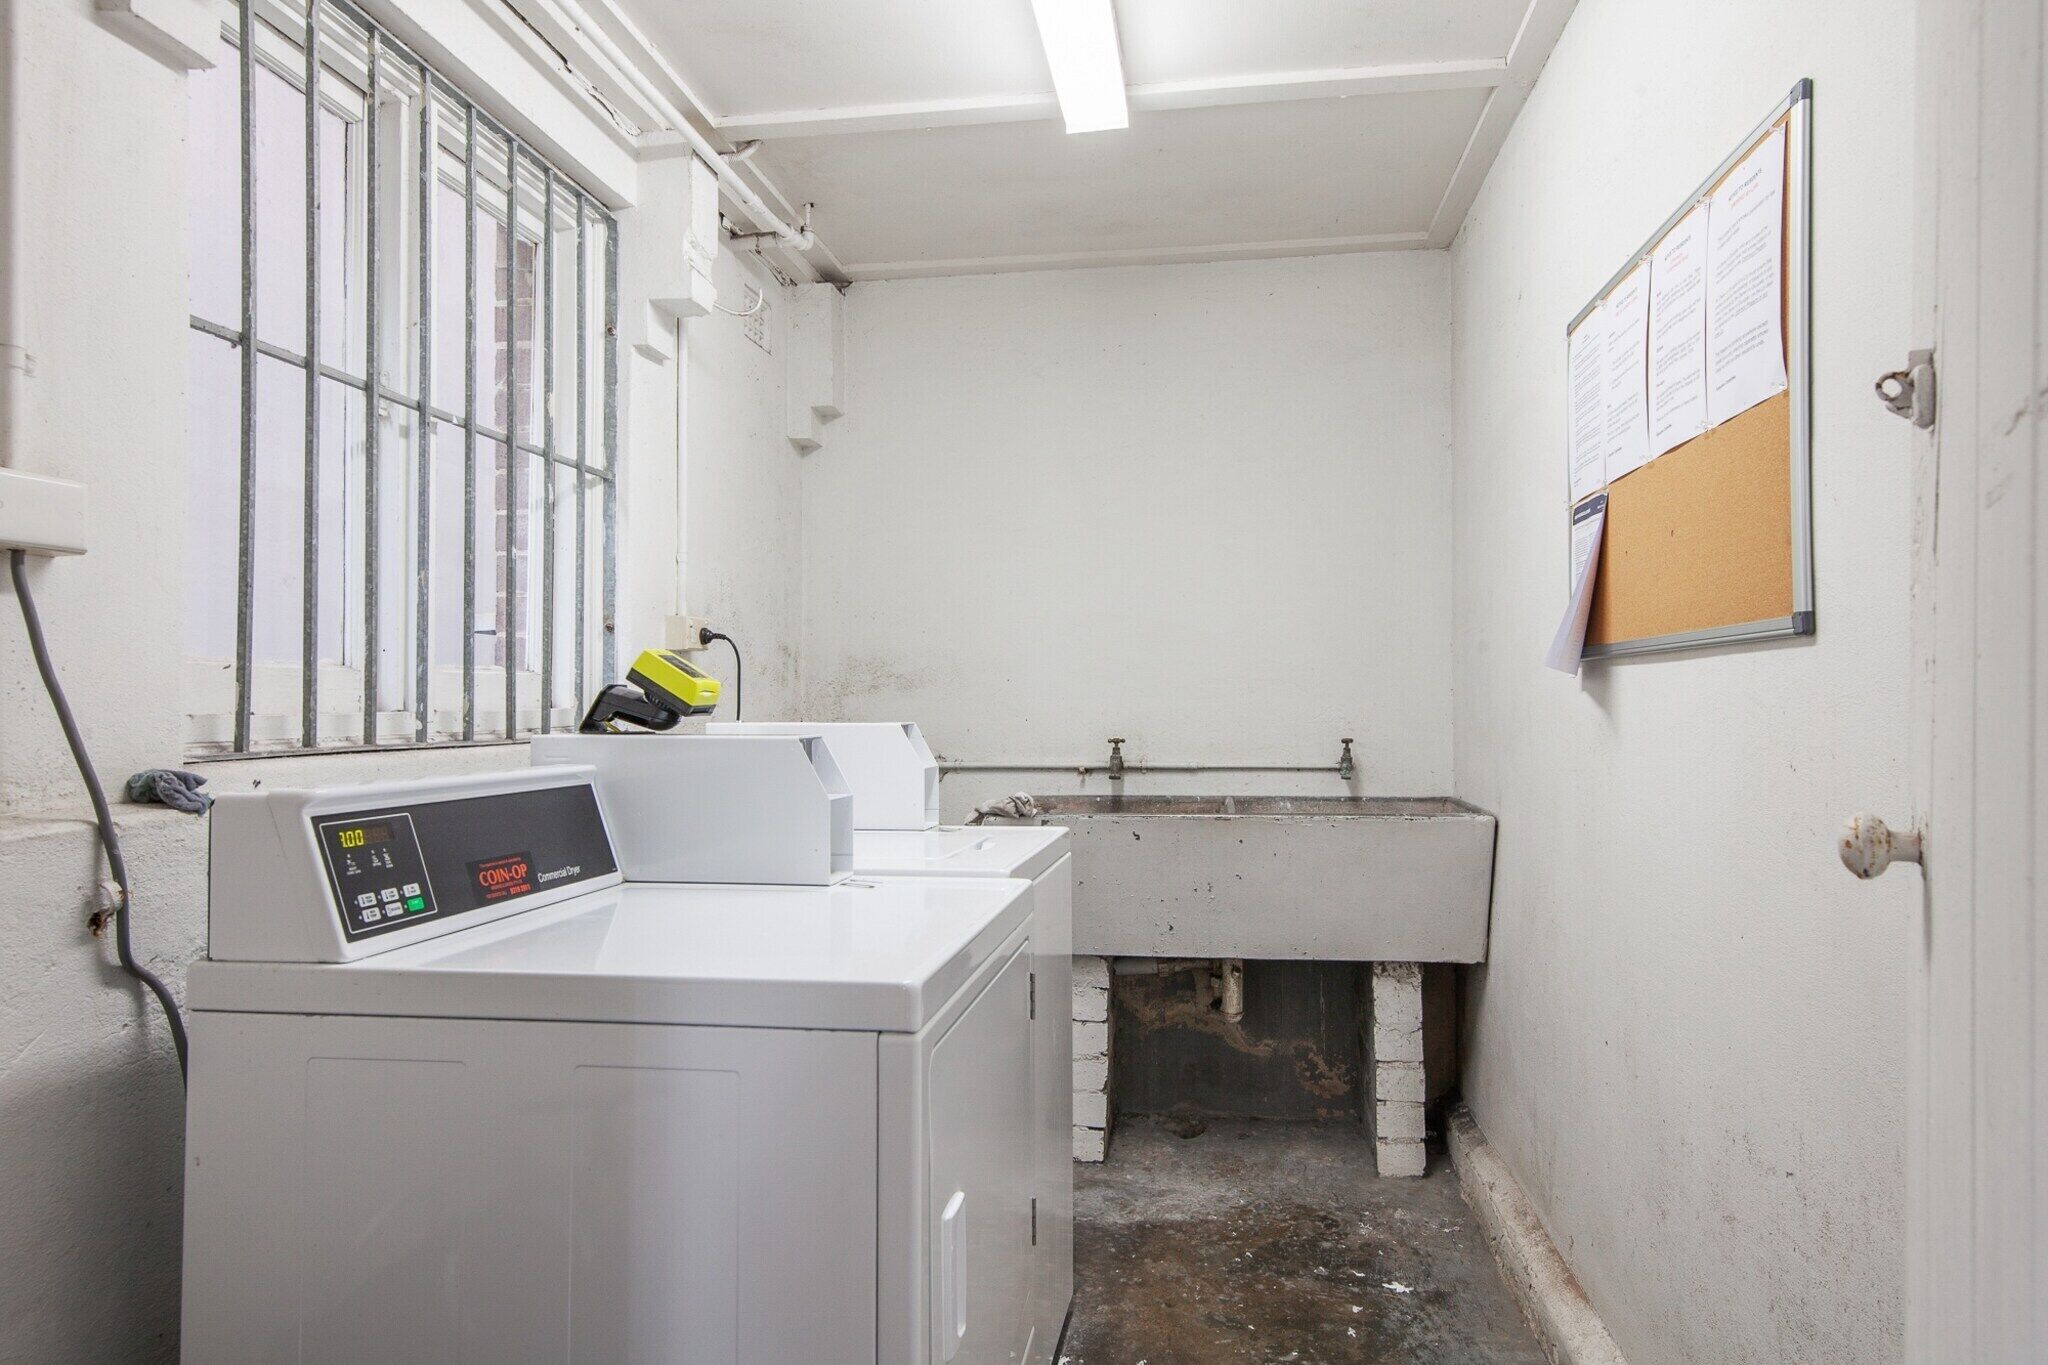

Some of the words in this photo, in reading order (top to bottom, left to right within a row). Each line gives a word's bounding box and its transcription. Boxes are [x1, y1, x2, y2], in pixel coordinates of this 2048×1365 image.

[479, 863, 527, 887] COIN-OP
[537, 867, 567, 883] Commercial
[566, 865, 581, 877] Dryer
